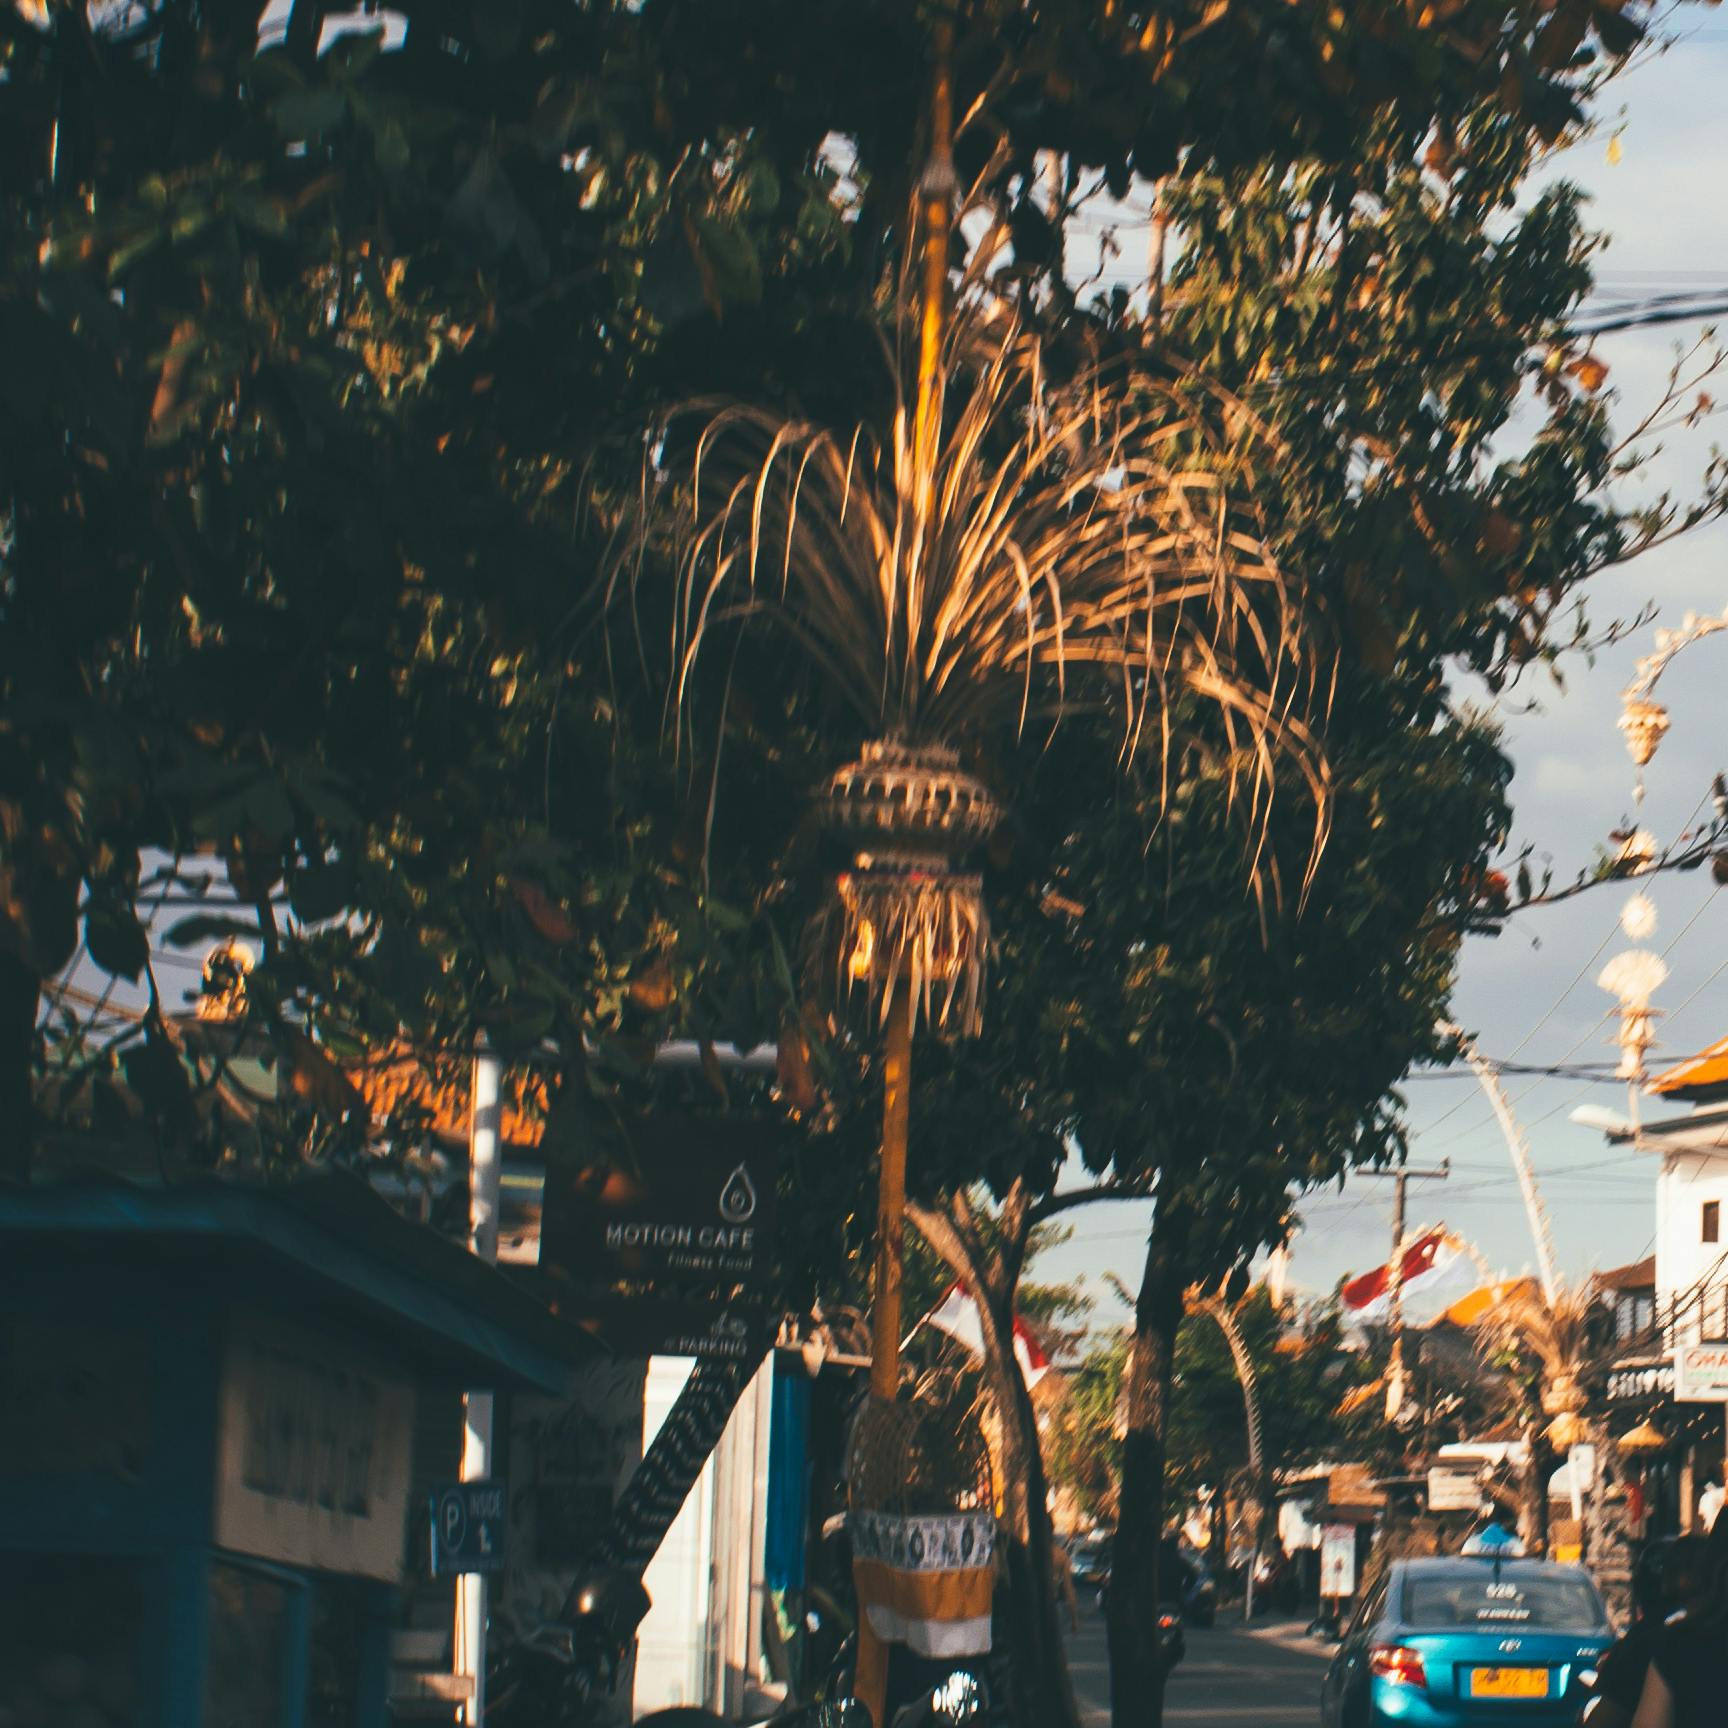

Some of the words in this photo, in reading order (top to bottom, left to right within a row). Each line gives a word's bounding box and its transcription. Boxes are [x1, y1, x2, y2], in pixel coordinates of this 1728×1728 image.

[606, 1223, 692, 1250] MOTION
[698, 1226, 754, 1250] CAFE
[678, 1335, 748, 1358] PARKING
